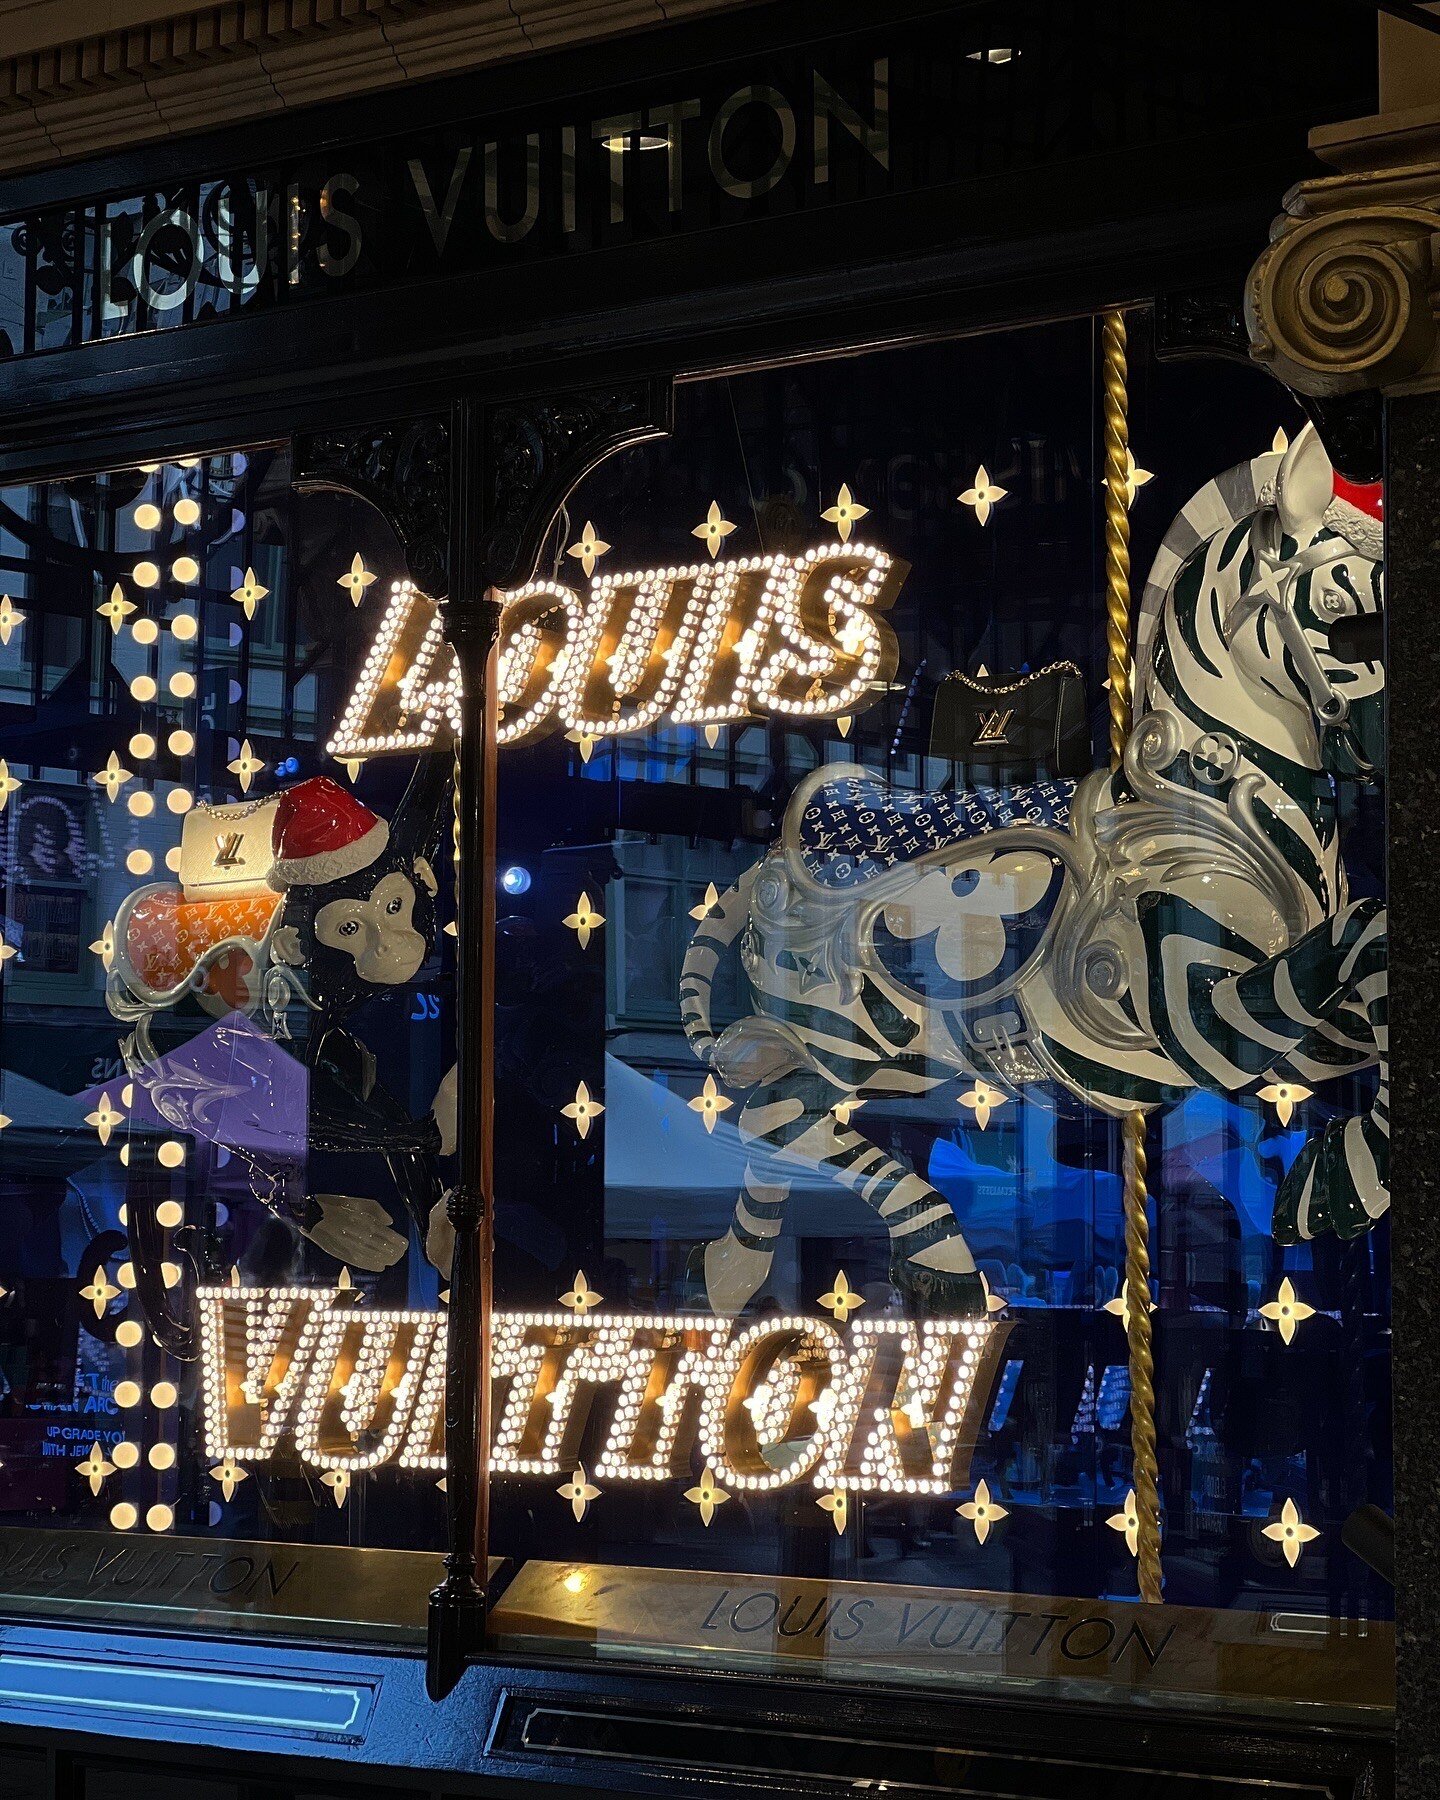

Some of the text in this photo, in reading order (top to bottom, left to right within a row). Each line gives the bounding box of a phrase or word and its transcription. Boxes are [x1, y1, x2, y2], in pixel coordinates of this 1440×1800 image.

[101, 57, 890, 321] LOUIS VUITTON
[325, 542, 893, 757] LOUIS
[86, 1547, 300, 1599] VUITTON
[701, 1590, 1177, 1667] LOUIS VUITTON
